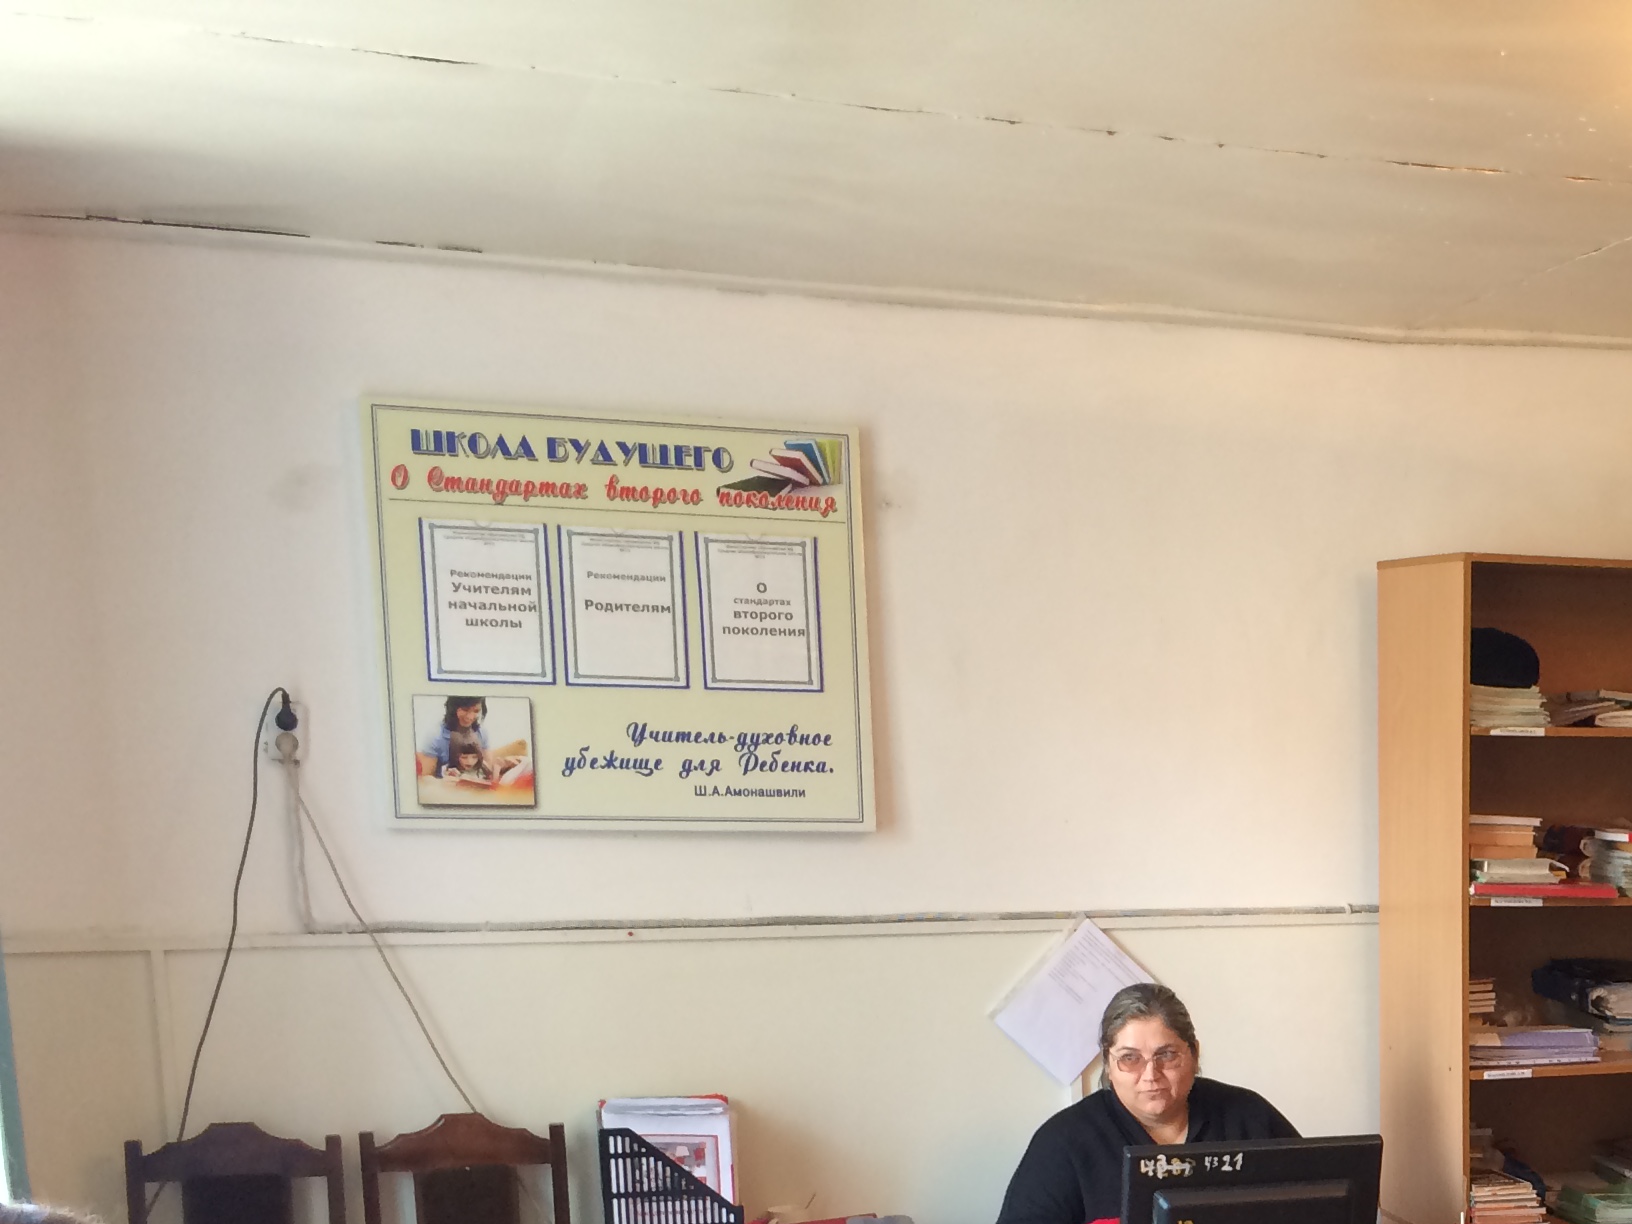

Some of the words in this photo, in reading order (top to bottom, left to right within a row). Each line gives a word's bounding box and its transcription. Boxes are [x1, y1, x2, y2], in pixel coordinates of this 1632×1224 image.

[410, 428, 538, 462] ШКОЛА
[546, 436, 734, 473] БУДУЩЕГО
[390, 463, 410, 490] О
[426, 465, 589, 505] Стандартах
[605, 474, 703, 508] второго
[718, 488, 838, 518] поколения
[450, 569, 532, 581] Рекомендации
[586, 570, 666, 582] Рекомендации
[451, 582, 532, 596] Учителям
[756, 582, 767, 593] О
[448, 600, 537, 612] начальной
[584, 599, 671, 613] Родителям
[733, 597, 791, 606] стандартах
[733, 610, 794, 622] второго
[465, 617, 523, 628] школы
[722, 626, 806, 637] поколения
[626, 721, 833, 752] Учитель-духовное
[561, 746, 664, 778] убежище
[678, 757, 722, 779] для
[738, 749, 834, 776] Ребенка.
[694, 785, 806, 798] Ш.А.Амонашвили
